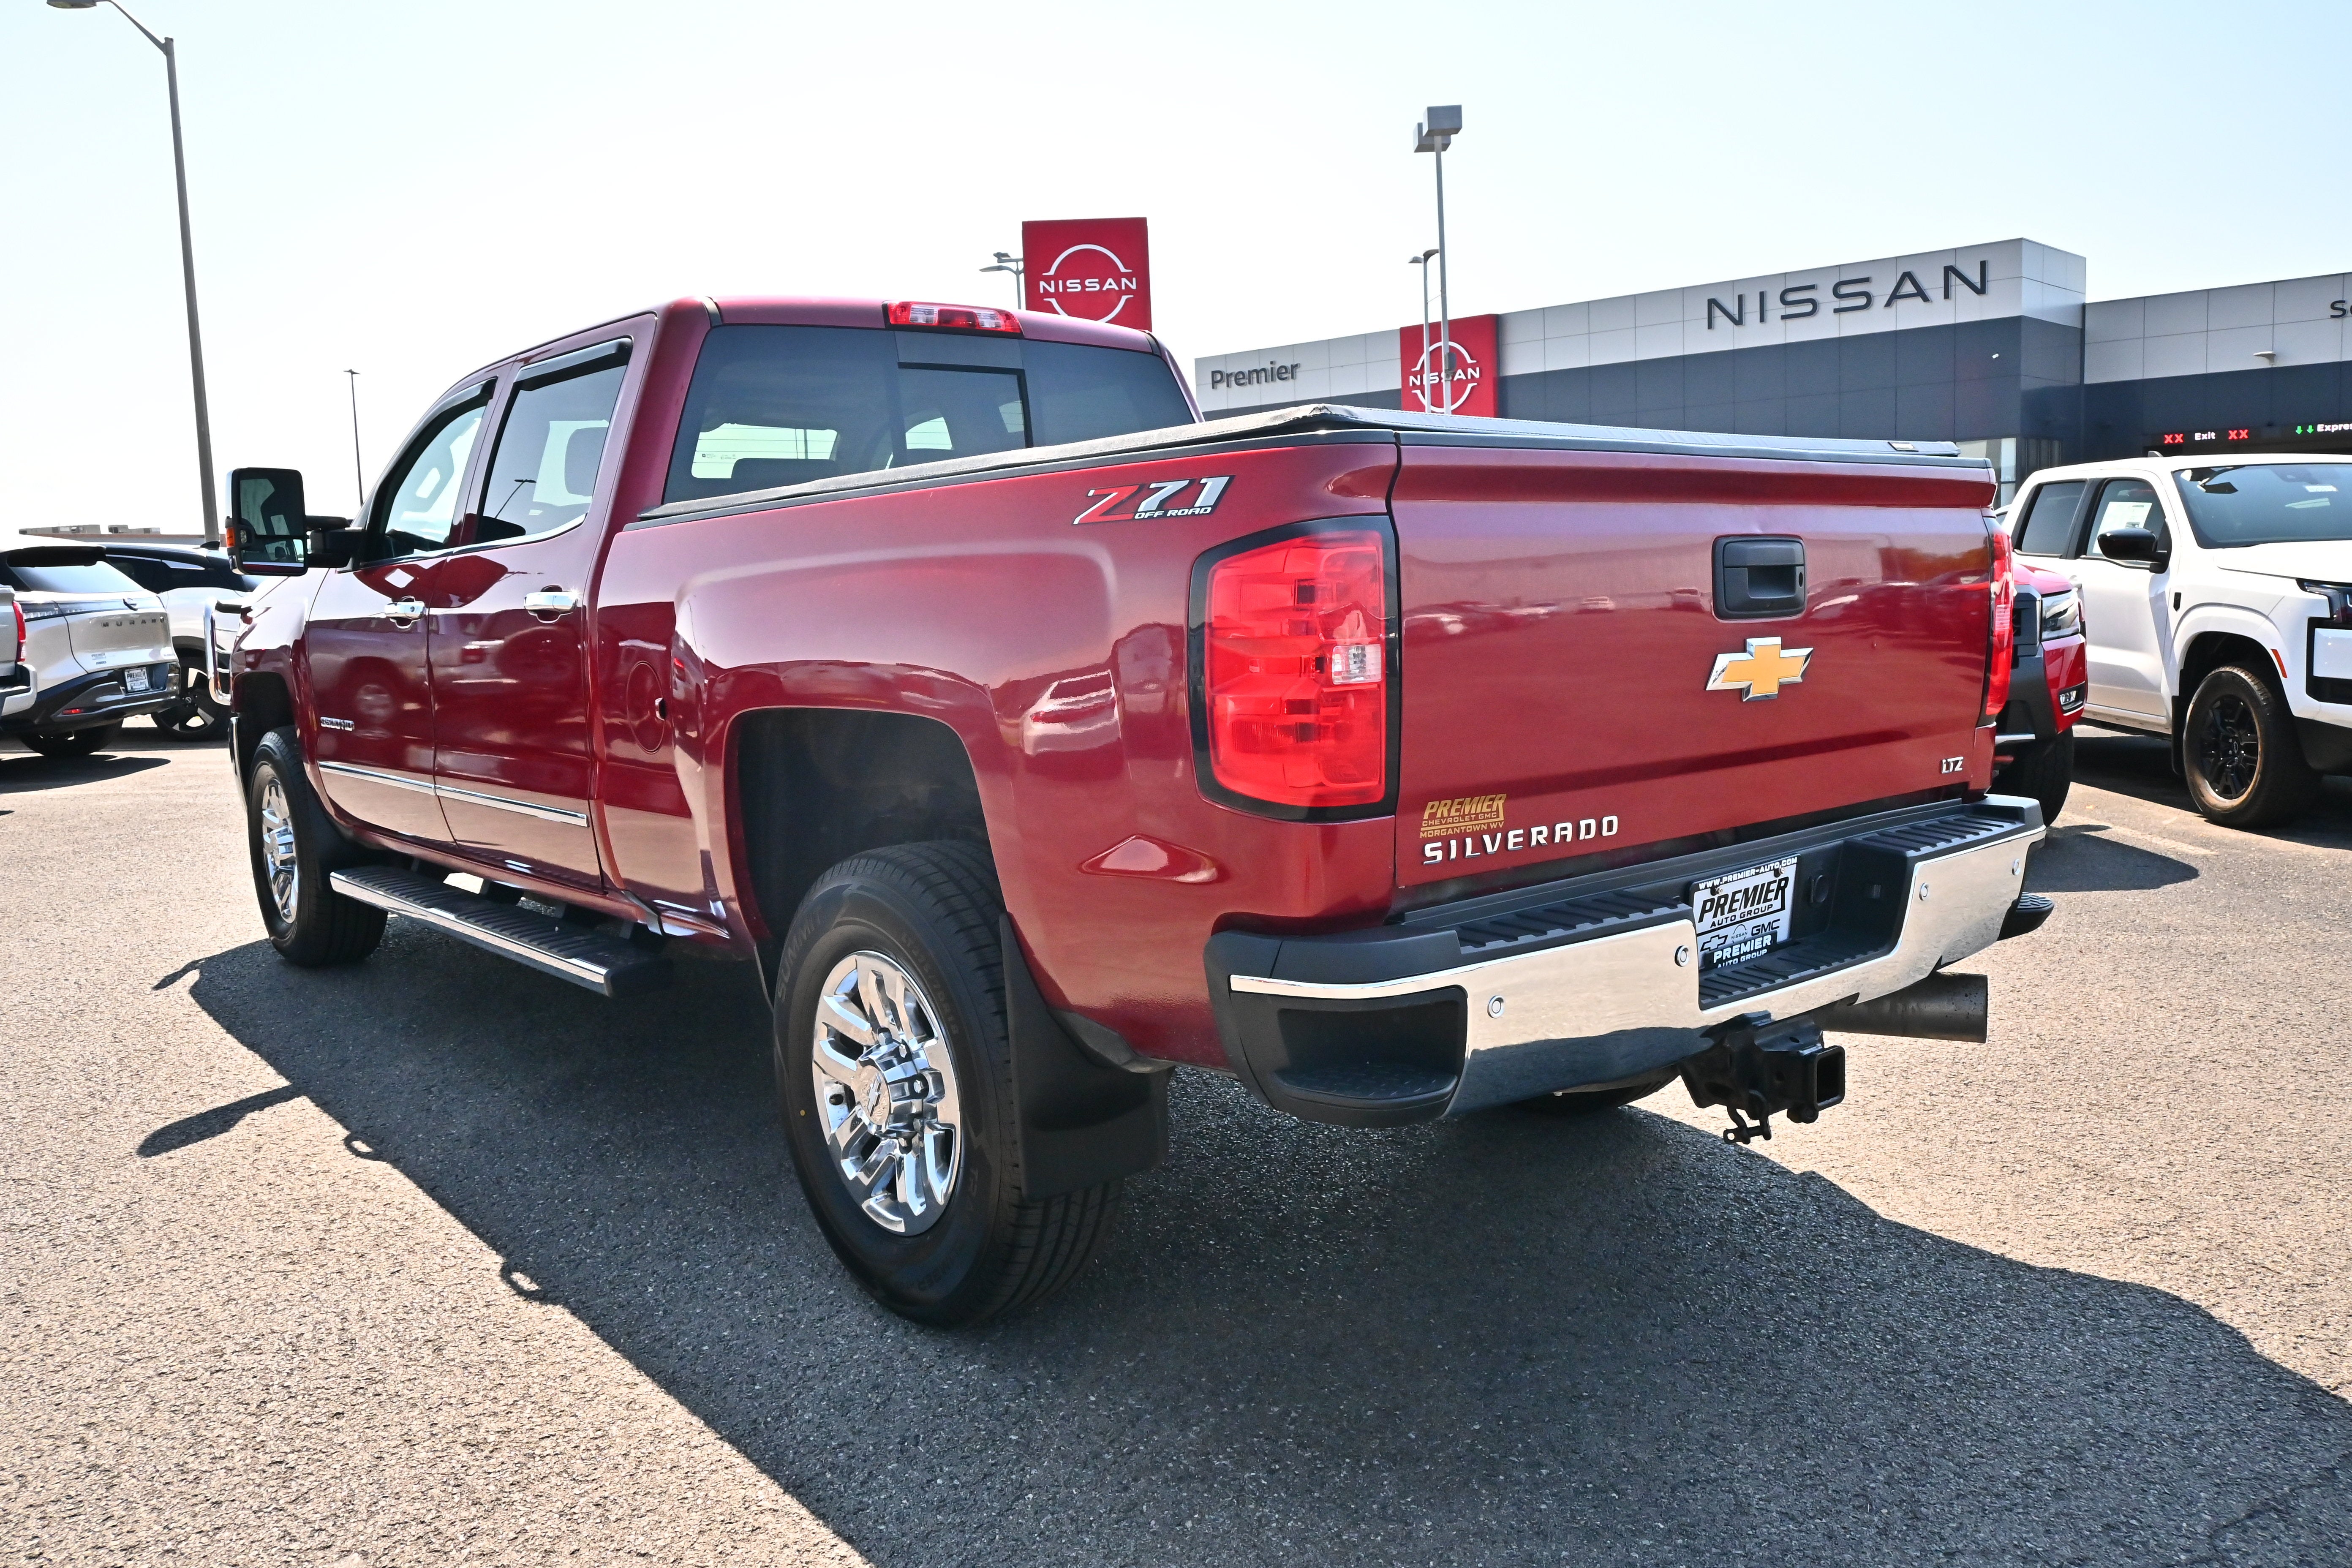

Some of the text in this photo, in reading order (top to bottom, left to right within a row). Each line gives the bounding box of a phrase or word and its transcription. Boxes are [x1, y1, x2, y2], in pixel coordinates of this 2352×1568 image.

[1040, 277, 1137, 294] NISSAN
[1707, 260, 1988, 330] NISSAN
[2330, 299, 2352, 318] S
[1211, 360, 1299, 389] Premier
[2194, 432, 2216, 441] Exit
[1073, 476, 1231, 525] Z71
[1134, 507, 1212, 520] OFF ROAD
[127, 671, 147, 680] PREMIER
[1941, 756, 1964, 774] LTZ
[1423, 793, 1507, 821] PREMIER
[1420, 821, 1504, 838] MORGANTOWN WV
[1422, 811, 1497, 827] CHEVROLET GMC
[1423, 815, 1619, 865] SILVERADO
[1699, 857, 1797, 890] WWW.PREMIER-AUTO.COM
[1698, 877, 1789, 923] PREMIER
[1710, 904, 1773, 928] AUTO GROUP
[1731, 919, 1781, 940] NISSAN GMC
[1713, 934, 1772, 964] PREMIER
[1717, 949, 1767, 969] AUTO GROUP
